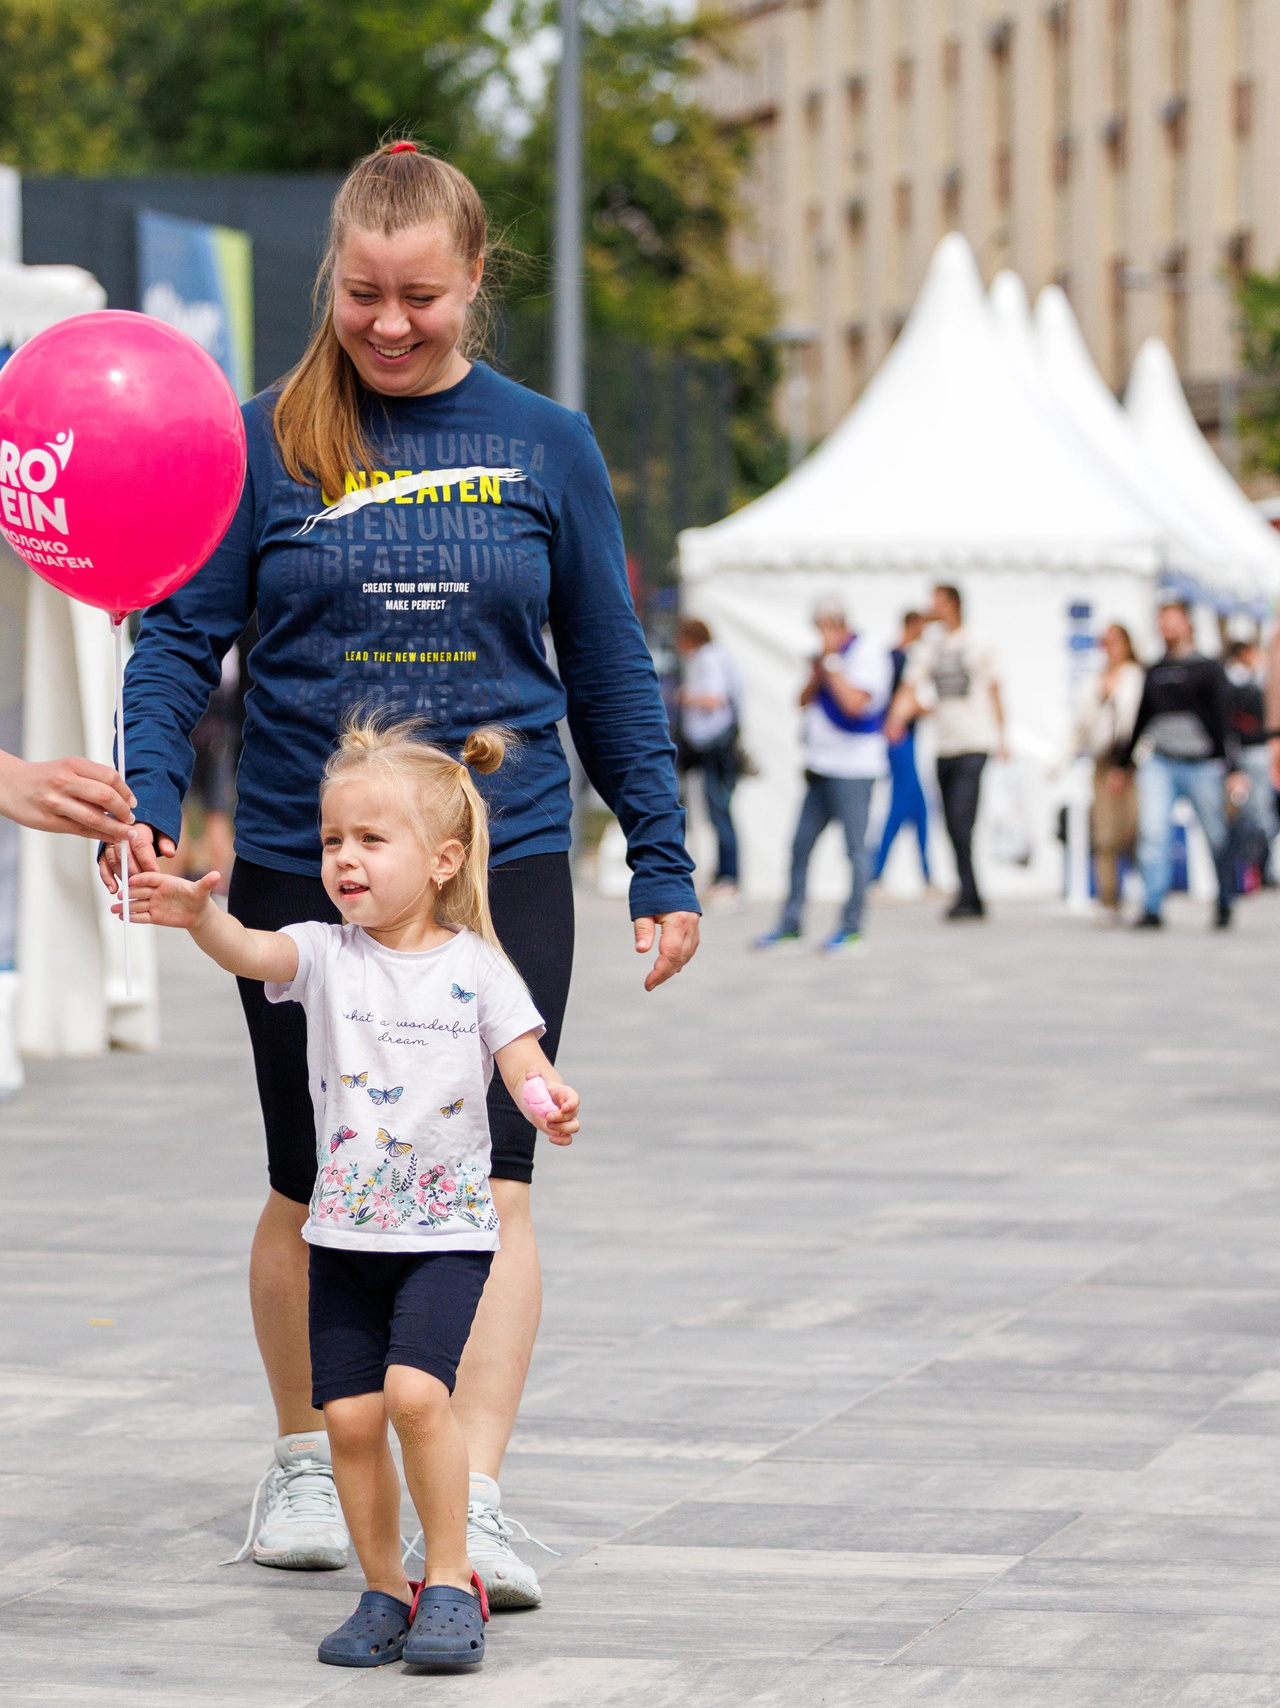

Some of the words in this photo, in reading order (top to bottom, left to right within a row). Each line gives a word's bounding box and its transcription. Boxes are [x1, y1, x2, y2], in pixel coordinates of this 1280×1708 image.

[13, 544, 94, 569] ОЛЛАГЕН
[362, 583, 392, 593] CREATE
[394, 583, 416, 593] YOUR
[417, 582, 437, 593] OWN
[438, 582, 470, 593] FUTURE
[385, 600, 409, 611] MAKE
[411, 600, 446, 610] PERFECT
[345, 651, 369, 661] LEAD
[373, 652, 392, 662] THE
[395, 652, 417, 662] NEW
[419, 651, 477, 663] GENERATION
[396, 1018, 478, 1039] wonderful
[377, 1032, 429, 1046] dream
